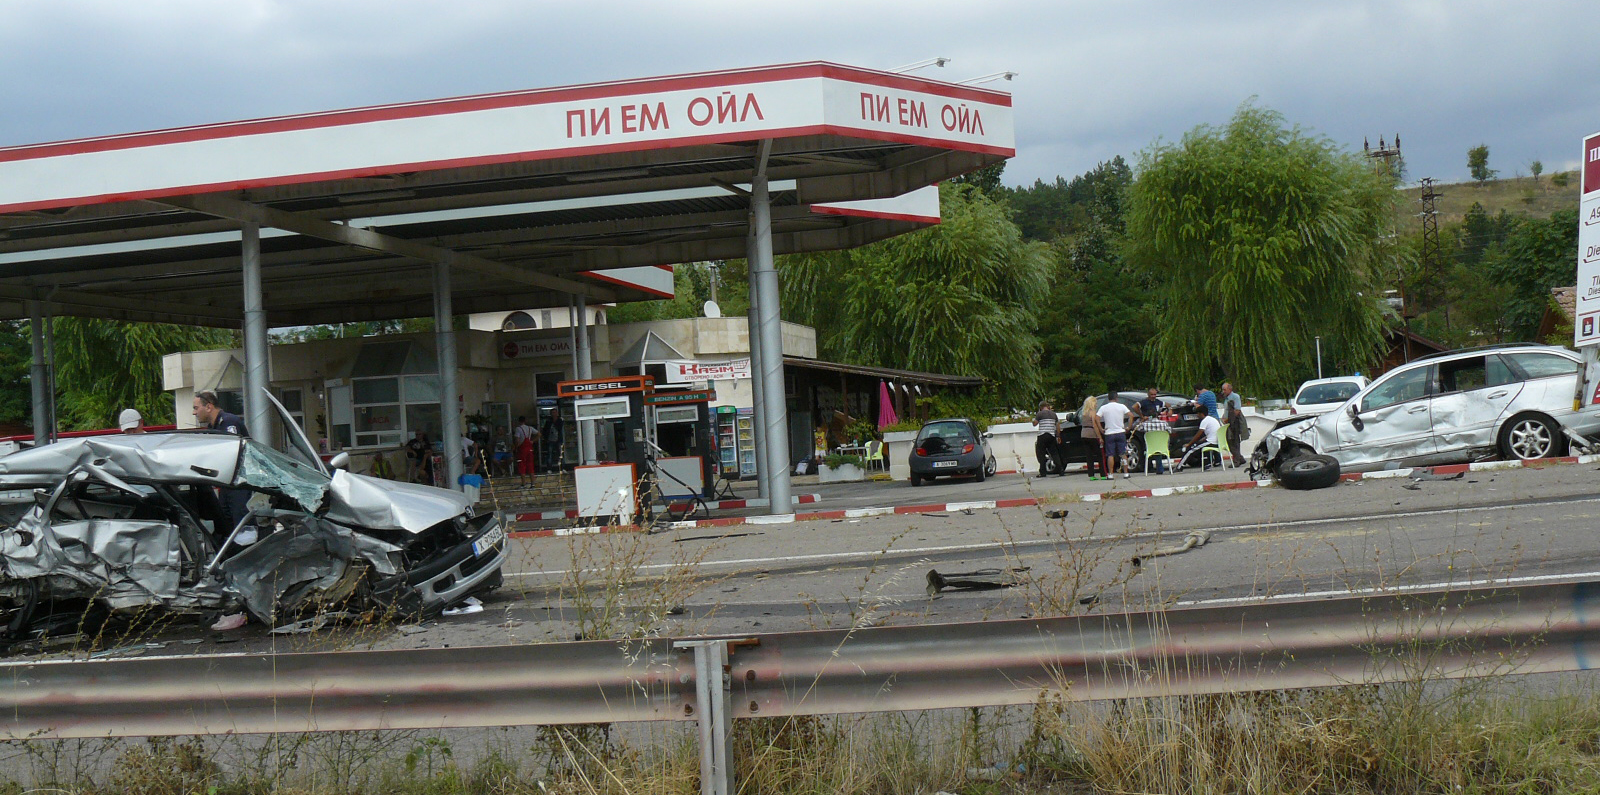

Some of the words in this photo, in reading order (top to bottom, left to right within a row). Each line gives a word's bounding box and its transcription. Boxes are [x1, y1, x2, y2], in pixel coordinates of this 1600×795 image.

[566, 107, 610, 138] ПИ
[621, 101, 669, 133] ЕМ
[687, 91, 764, 126] ОЙЛ
[860, 92, 890, 123] ПИ
[897, 97, 928, 129] ЕМ
[941, 103, 985, 136] ОЙЛ
[679, 364, 734, 375] KASIM
[574, 382, 627, 391] DIESEL
